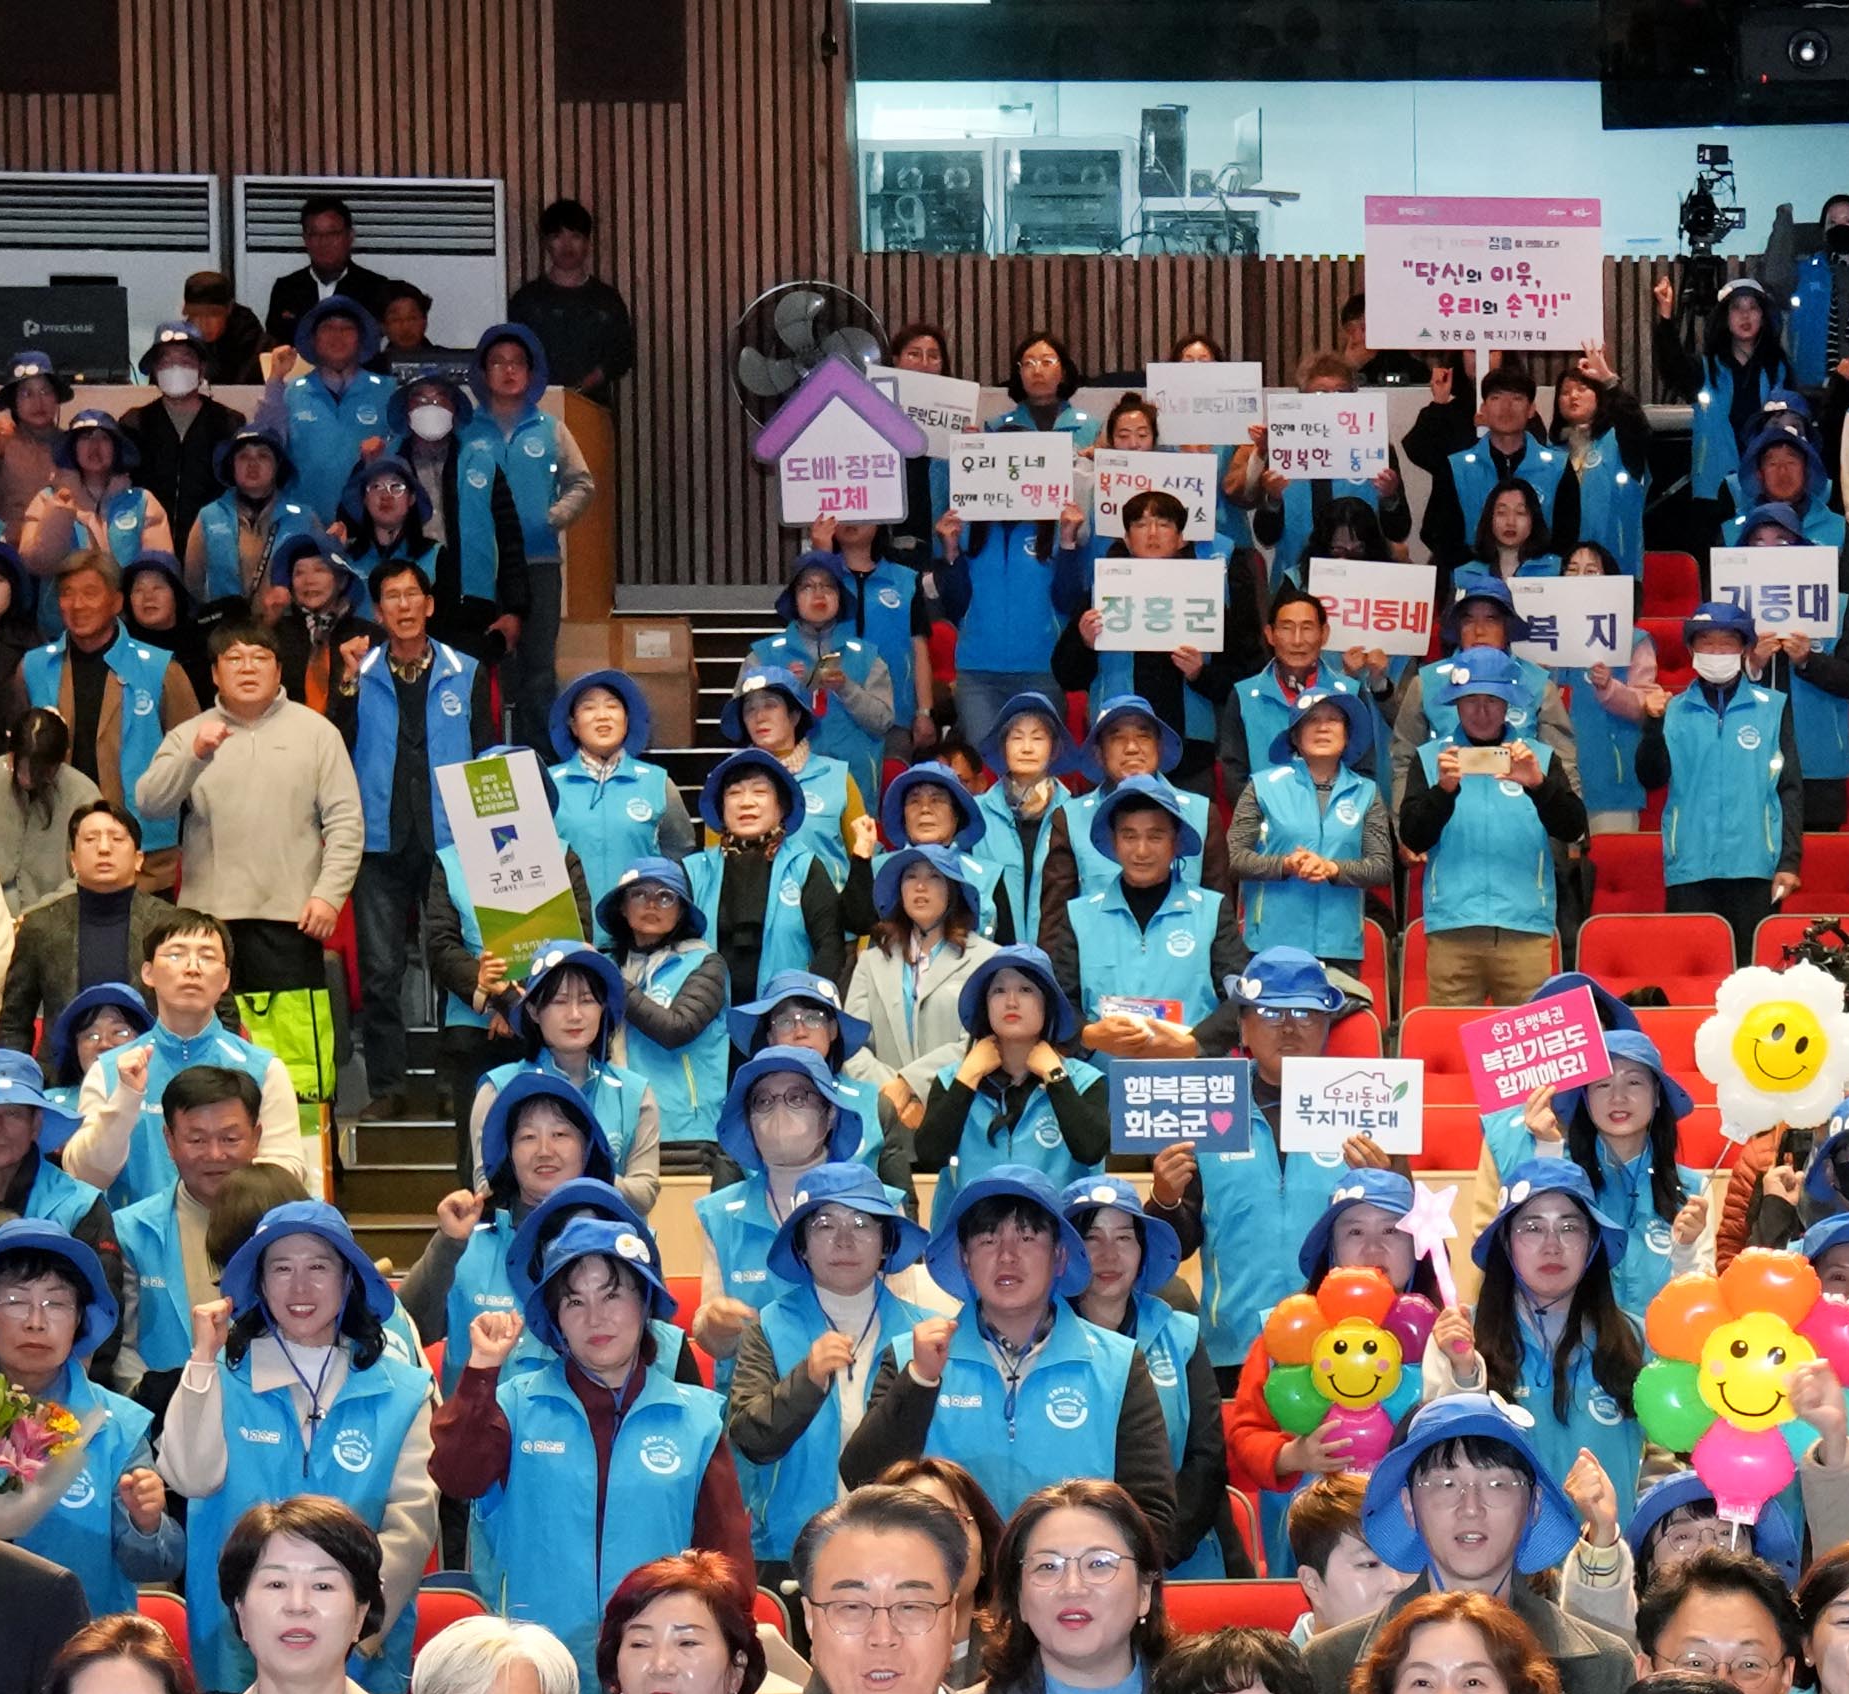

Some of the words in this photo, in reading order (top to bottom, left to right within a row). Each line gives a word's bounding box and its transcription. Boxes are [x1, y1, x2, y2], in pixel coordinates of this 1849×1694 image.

[1402, 260, 1482, 286] "당신의
[1490, 261, 1541, 288] 이웃,
[1438, 293, 1498, 318] 우리의
[1506, 292, 1571, 318] 손길!"
[786, 454, 897, 482] 도배·장판
[961, 455, 997, 475] 우리
[1007, 454, 1046, 481] 동네
[1271, 448, 1333, 472] 행복한
[1349, 447, 1386, 473] 동네
[817, 486, 869, 512] 교체
[1099, 472, 1153, 498] 복지의
[1162, 475, 1204, 498] 시작
[1101, 596, 1217, 635] 장흥군
[1720, 583, 1830, 624] 기동대
[489, 865, 545, 886] 구례군
[1514, 1006, 1566, 1036] 동행복권
[1481, 1023, 1589, 1073] 복권기금도
[1494, 1051, 1588, 1099] 함께해요!
[1123, 1075, 1236, 1105] 행복동행
[1328, 1086, 1391, 1107] 우리동네
[1124, 1109, 1208, 1138] 화순군
[1295, 1094, 1399, 1140] 복지기동대
